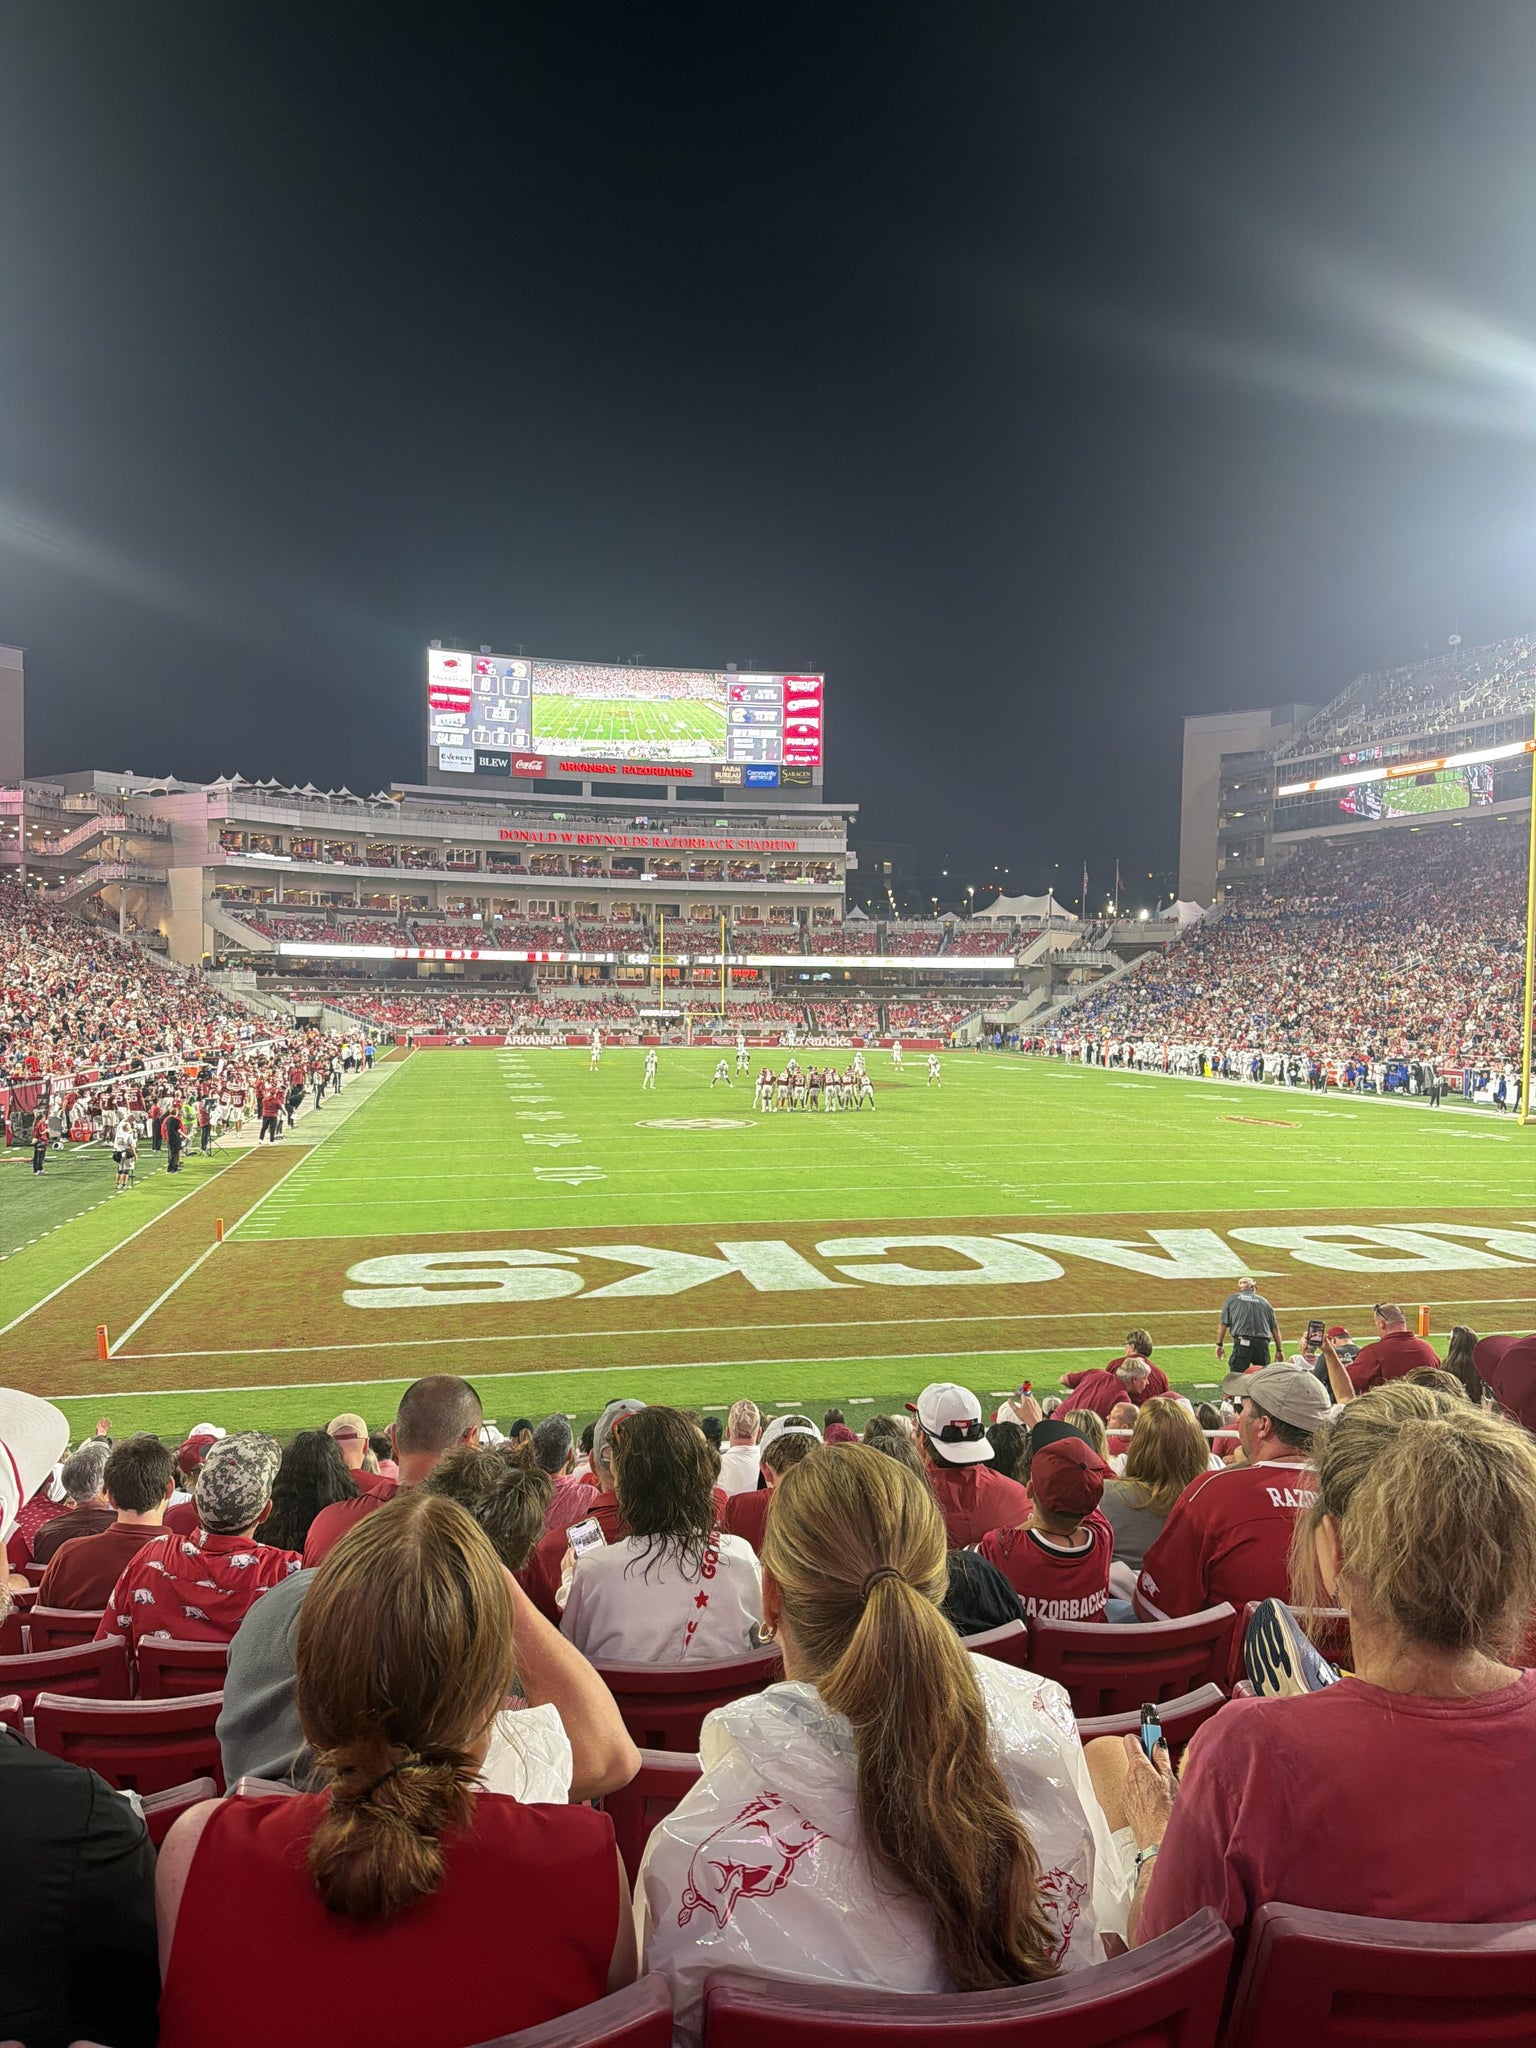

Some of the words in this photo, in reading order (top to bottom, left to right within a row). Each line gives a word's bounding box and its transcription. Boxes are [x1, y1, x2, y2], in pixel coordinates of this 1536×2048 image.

[479, 757, 508, 768] BLEW
[559, 761, 618, 775] ARKANSAS
[622, 764, 695, 778] RAZORBACKS
[714, 771, 742, 780] BUREAU
[499, 828, 558, 843] DONALD
[561, 833, 574, 843] W
[577, 833, 650, 847] REYNOLDS
[652, 836, 735, 849] RAZORBACK
[737, 839, 799, 851] STADIUM
[779, 1036, 851, 1047] RZRBACK
